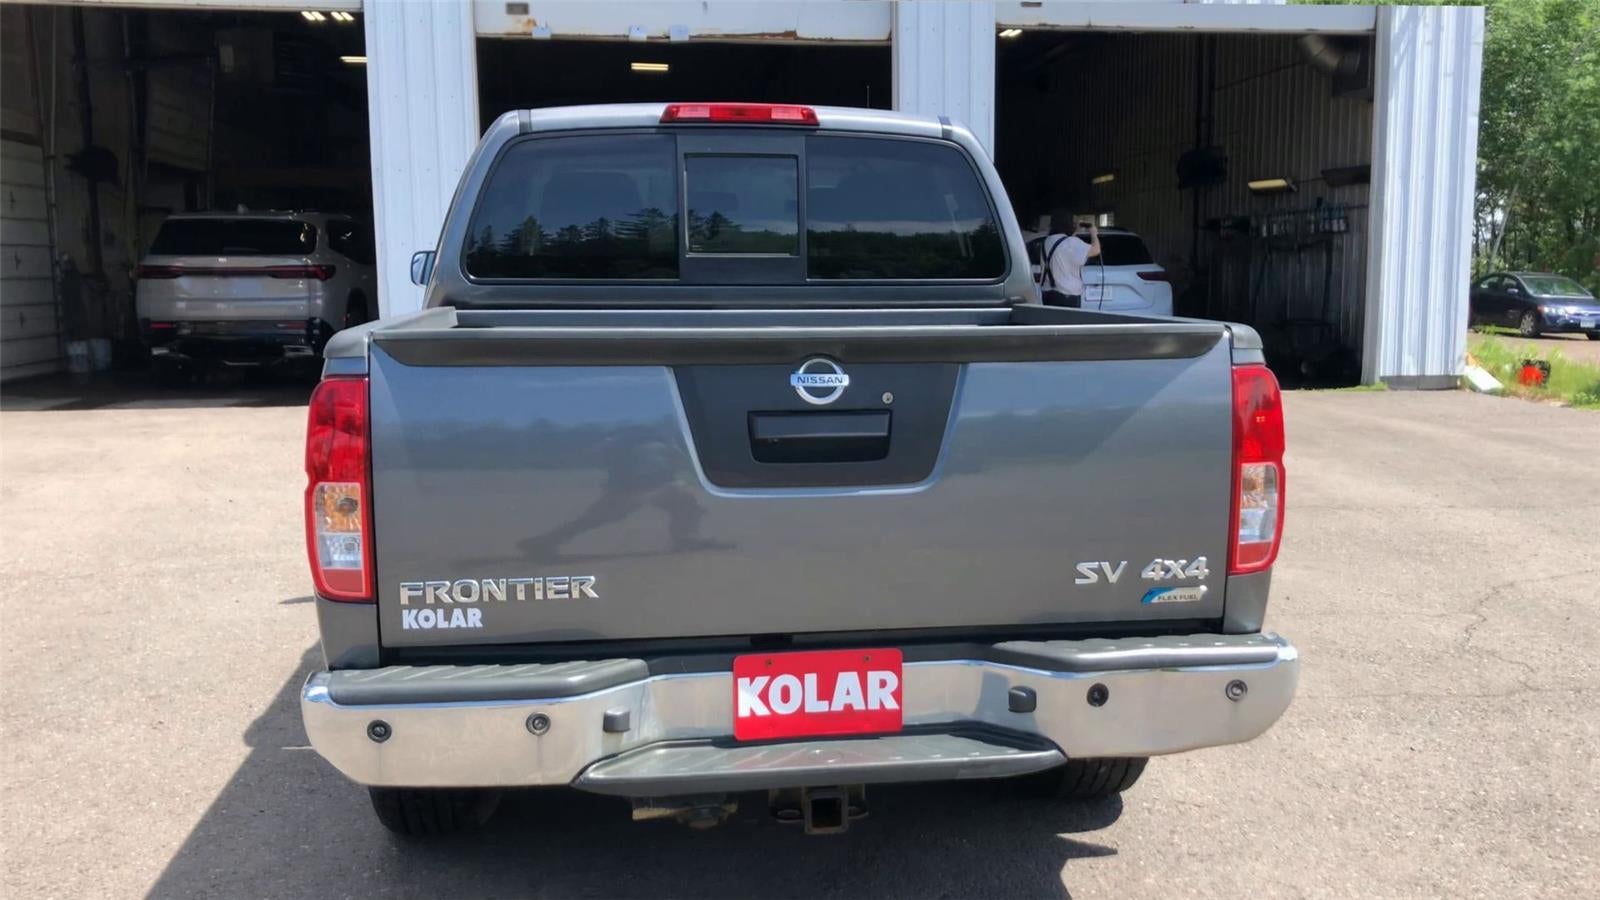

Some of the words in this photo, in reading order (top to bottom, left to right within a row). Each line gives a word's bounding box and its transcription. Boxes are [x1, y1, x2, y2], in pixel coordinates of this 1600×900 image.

[796, 375, 843, 384] NISSAN
[1075, 560, 1128, 584] SV
[399, 575, 599, 605] FRONTIER
[402, 608, 483, 630] KOLAR
[737, 670, 900, 717] KOLAR
